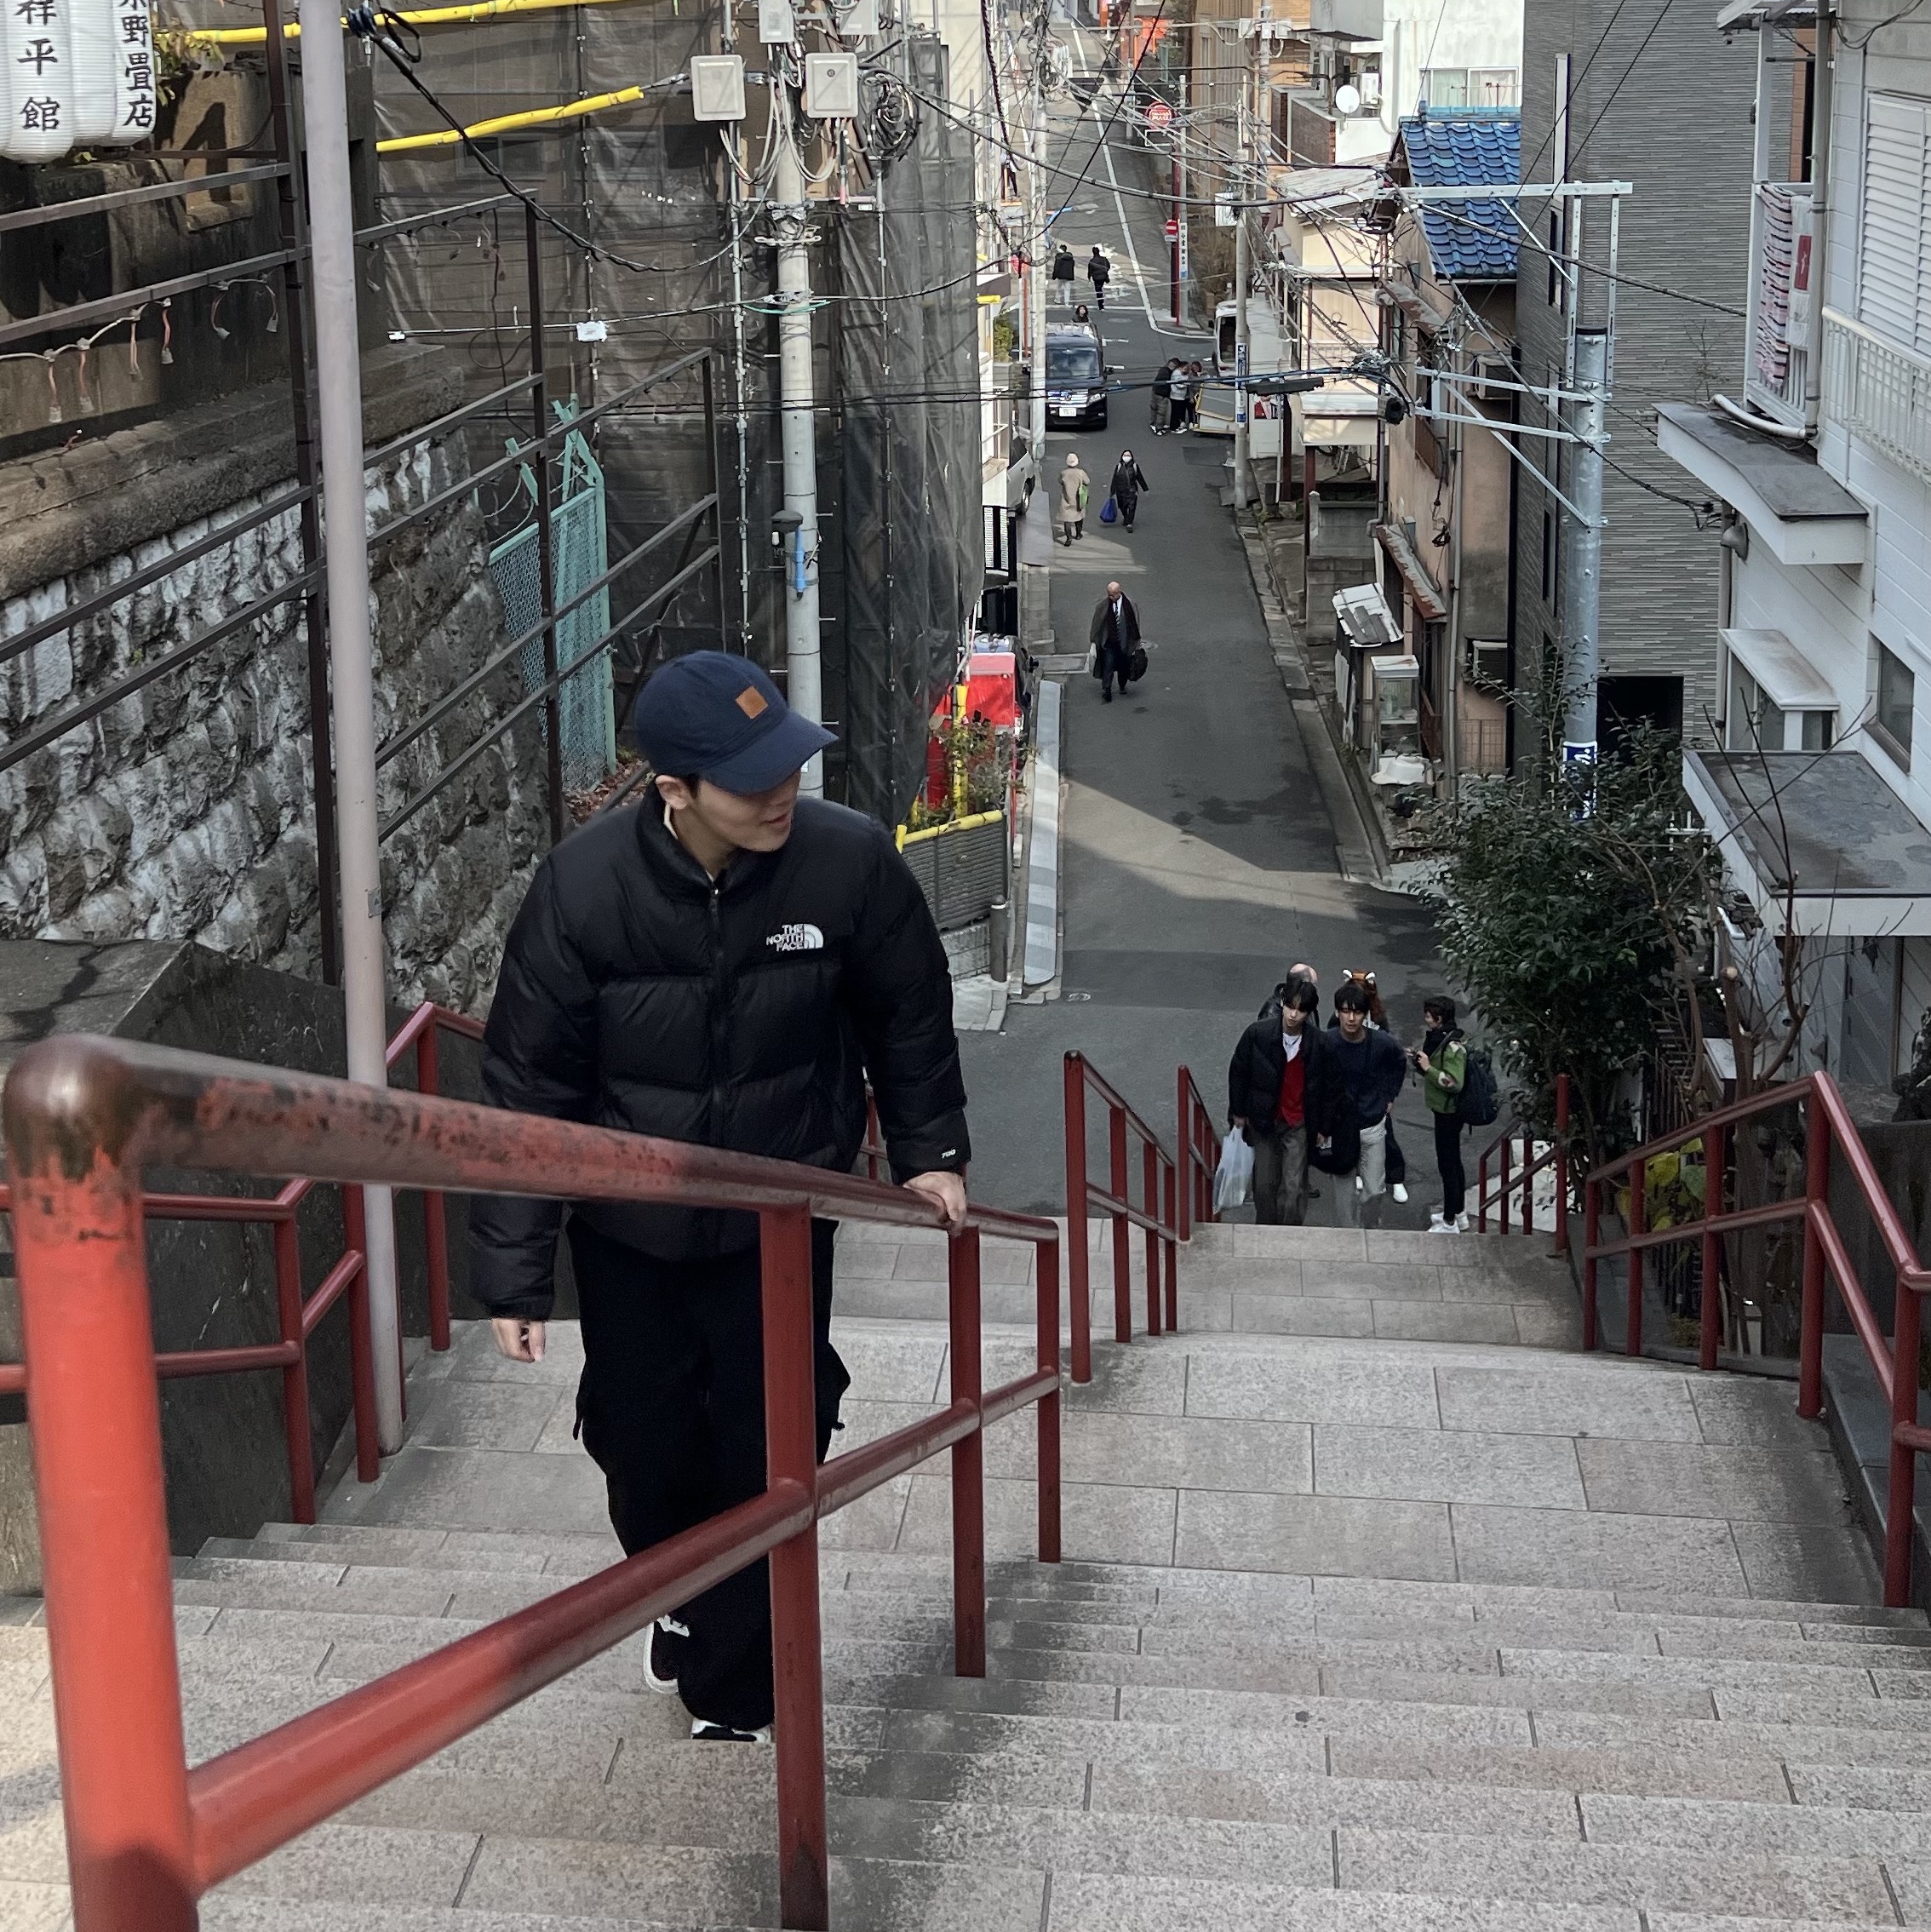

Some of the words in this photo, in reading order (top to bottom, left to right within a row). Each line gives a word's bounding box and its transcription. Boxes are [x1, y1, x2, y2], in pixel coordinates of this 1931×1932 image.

[14, 0, 60, 131] 祥平館
[782, 924, 804, 935] THE
[766, 933, 804, 945] NORTH
[776, 941, 805, 952] FACE
